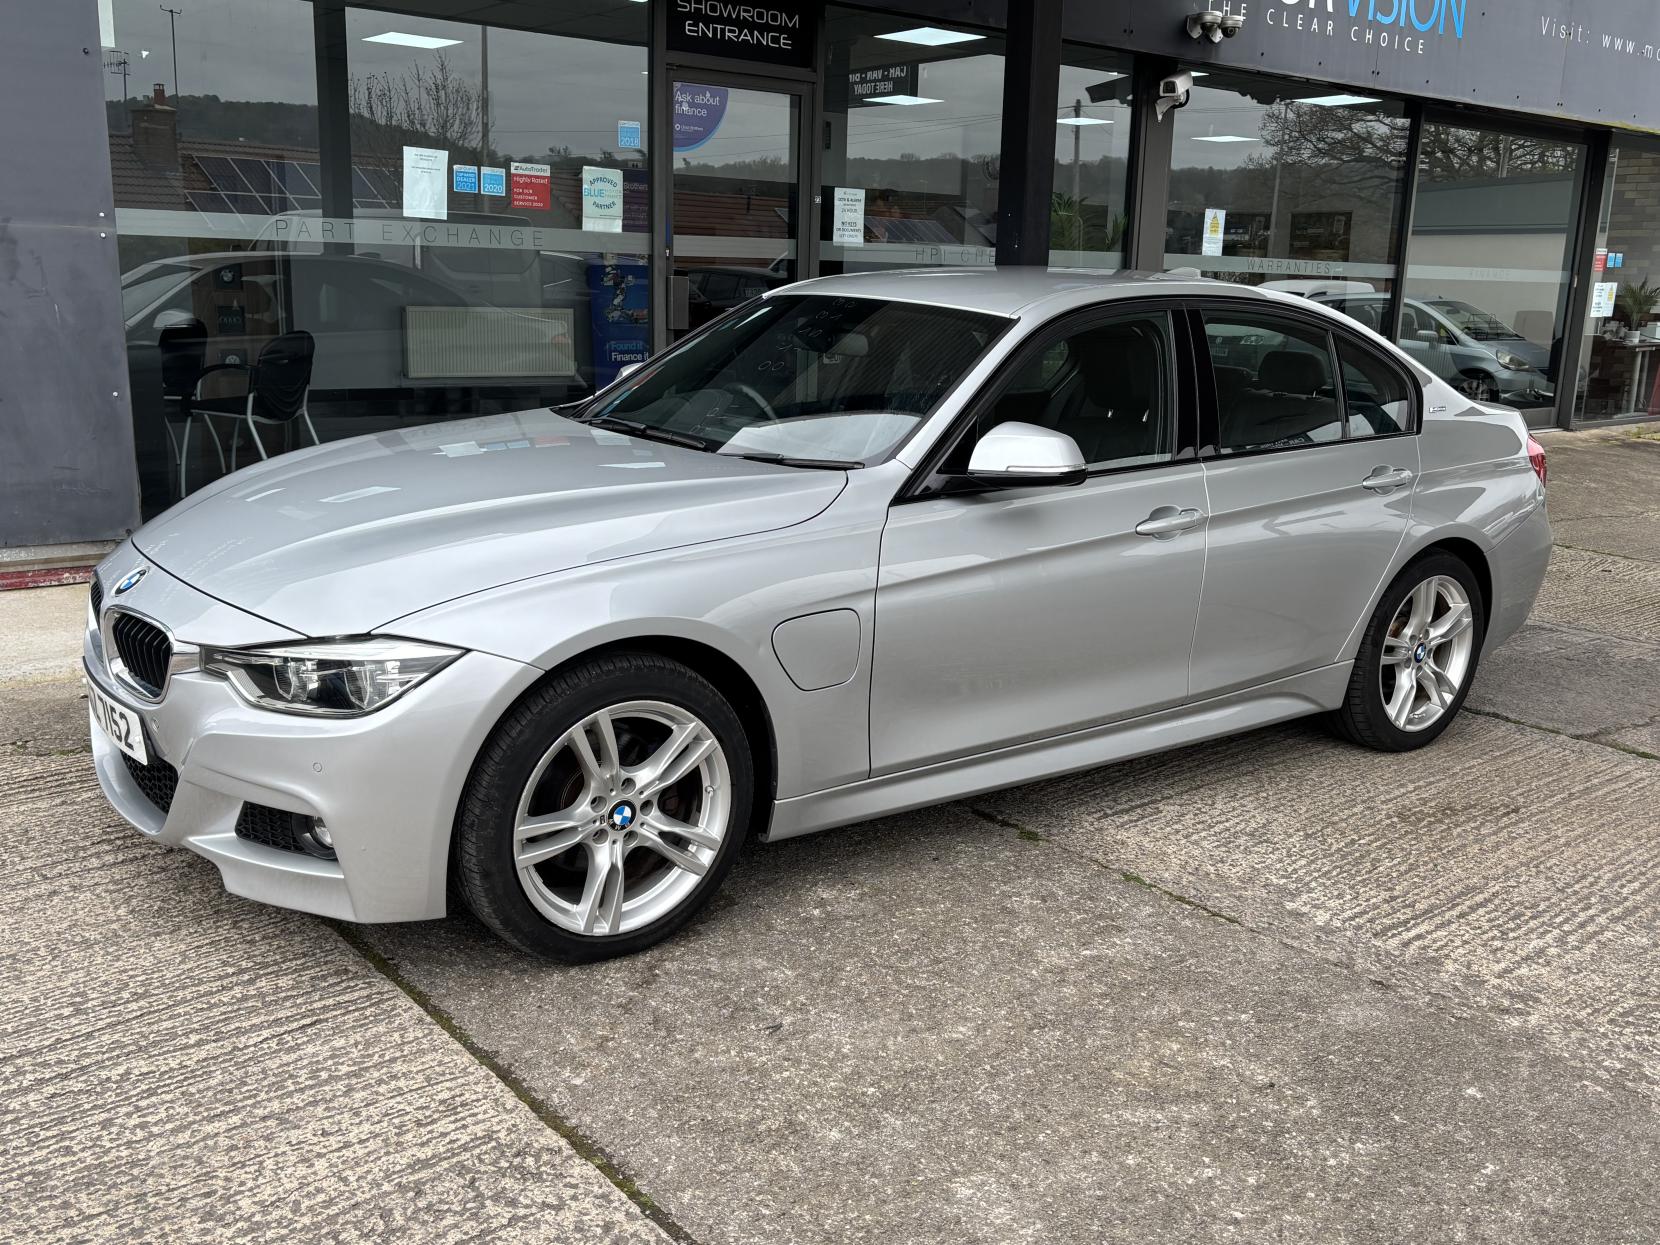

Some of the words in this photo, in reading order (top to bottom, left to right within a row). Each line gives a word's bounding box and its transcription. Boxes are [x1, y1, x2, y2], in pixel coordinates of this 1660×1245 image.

[677, 0, 799, 29] SHOWROOM
[685, 20, 792, 49] ENTRANCE
[1266, 8, 1334, 36] CLEAR
[1350, 26, 1425, 54] CHOICE
[1541, 15, 1590, 44] Visit:
[675, 90, 693, 103] Ask
[694, 94, 720, 106] about
[675, 103, 708, 117] finance
[620, 136, 640, 146] 2018
[520, 165, 548, 174] AutoTrader
[457, 181, 475, 191] 2021
[513, 175, 531, 184] Highly
[589, 176, 618, 188] APPROVED
[484, 183, 503, 193] 2020
[583, 186, 605, 198] BLUE
[592, 200, 617, 210] PARTNER
[274, 219, 355, 241] PART
[381, 224, 545, 247] EXCHANGE
[914, 247, 947, 263] HPI
[1247, 259, 1331, 274] WARRANTIES
[611, 352, 643, 361] Finance
[97, 693, 135, 752] 7152
